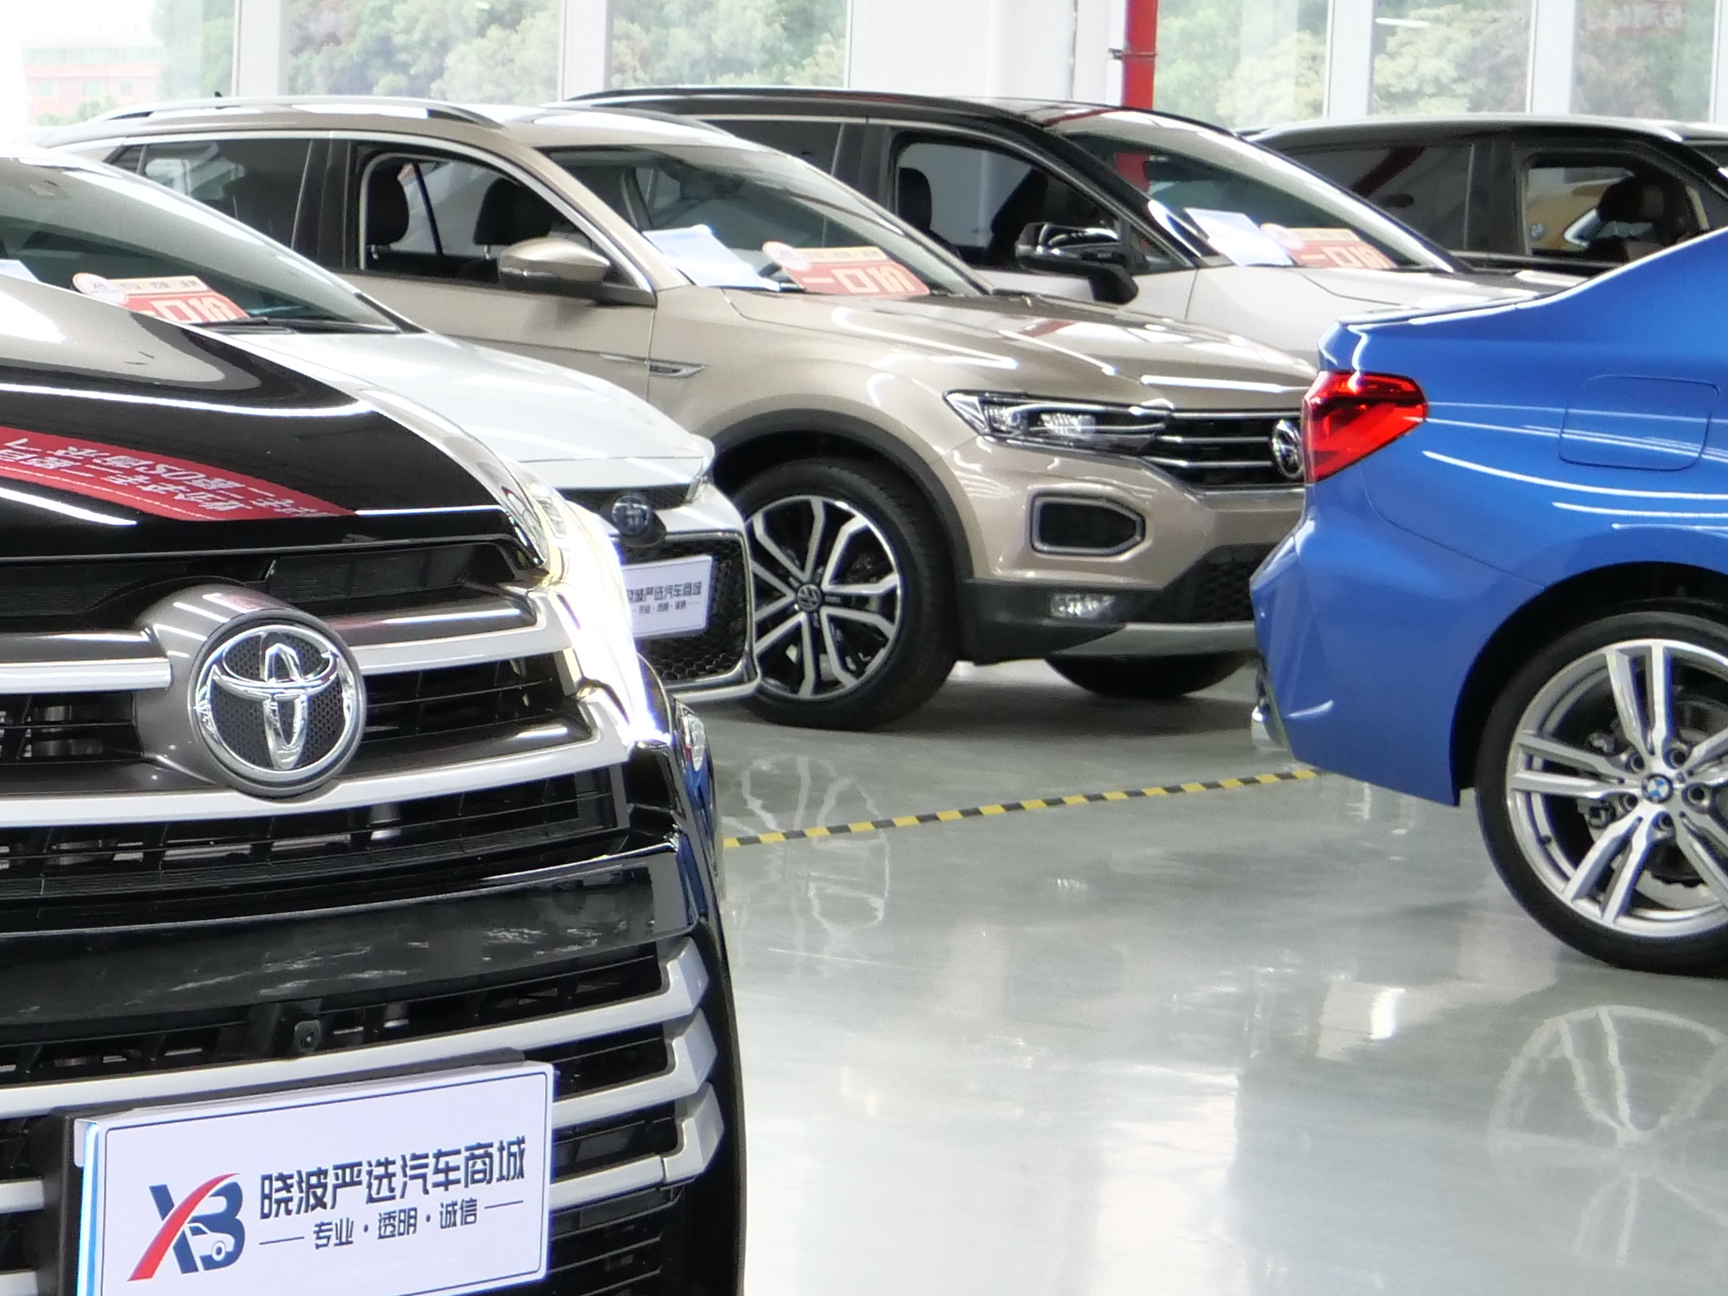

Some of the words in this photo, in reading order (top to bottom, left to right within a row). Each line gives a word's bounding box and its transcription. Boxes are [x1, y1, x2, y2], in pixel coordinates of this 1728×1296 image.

[802, 265, 916, 294] 一口价
[259, 1135, 526, 1220] 晓波严选汽车商城
